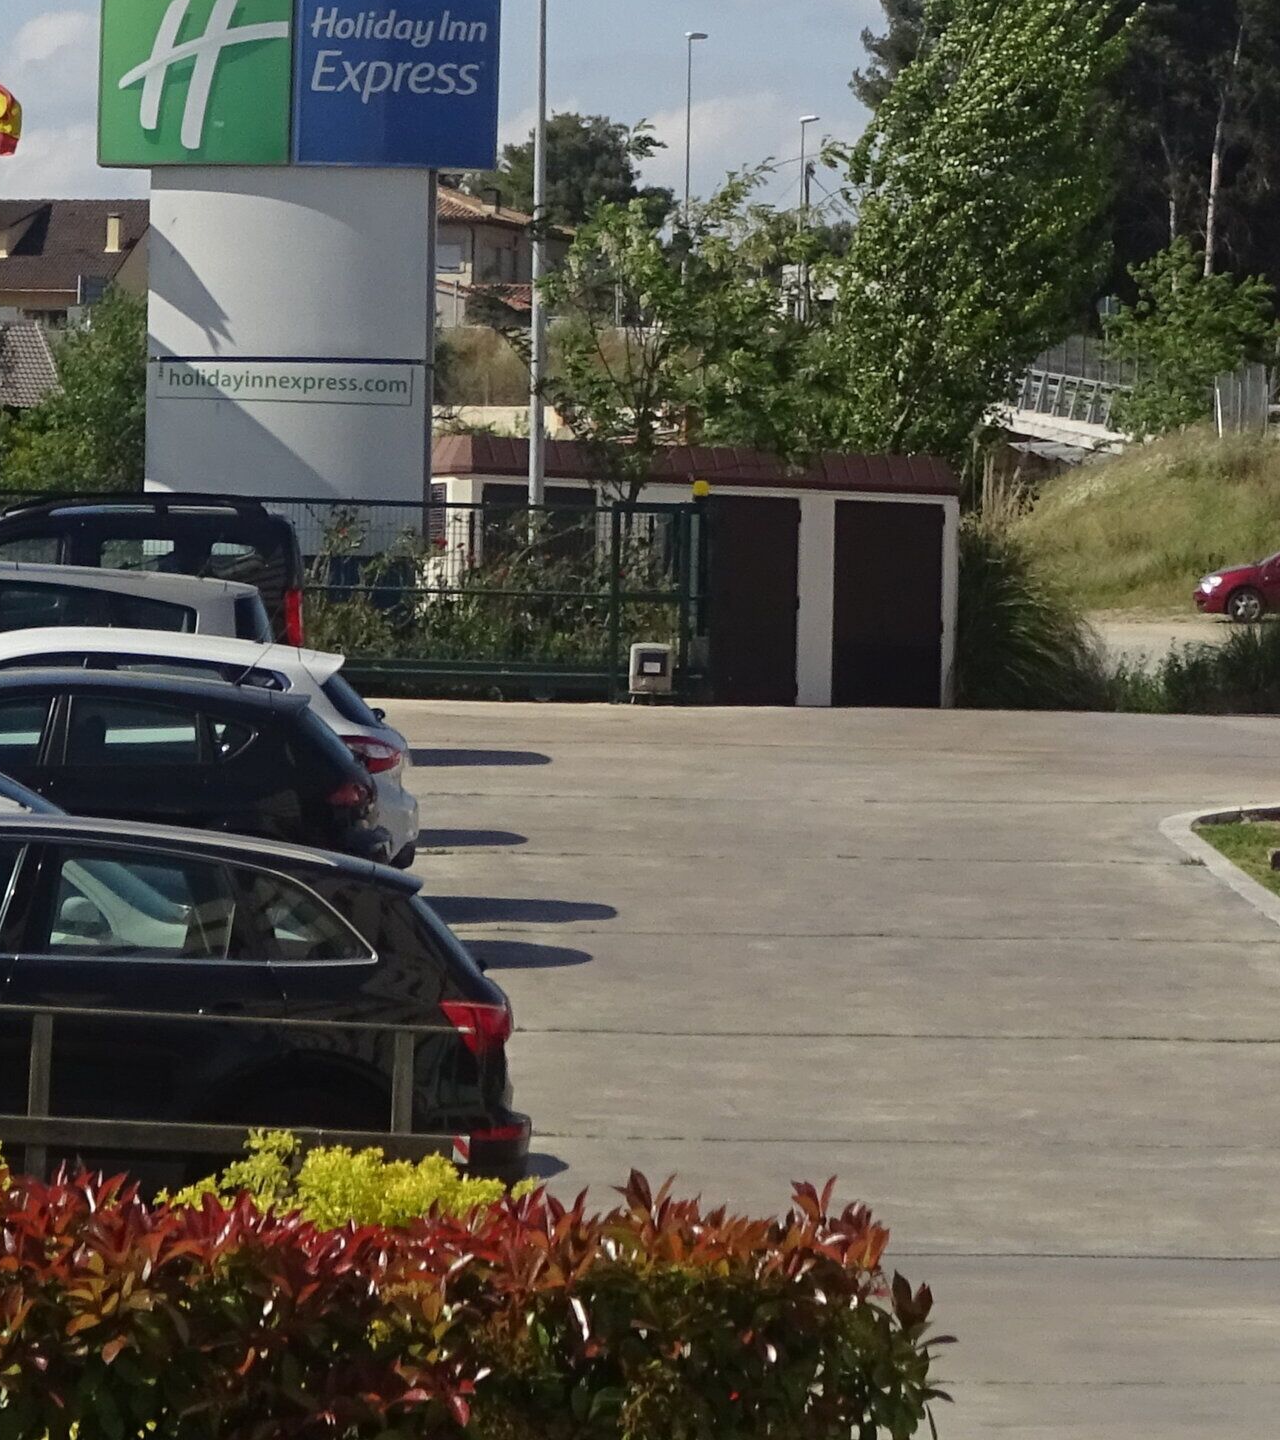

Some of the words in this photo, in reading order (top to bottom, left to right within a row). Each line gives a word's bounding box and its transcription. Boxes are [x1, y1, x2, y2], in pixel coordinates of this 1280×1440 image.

[310, 7, 434, 48] Holiday
[438, 10, 487, 42] Inn
[310, 50, 480, 104] Express
[169, 367, 408, 394] holidayinnexpress.com
